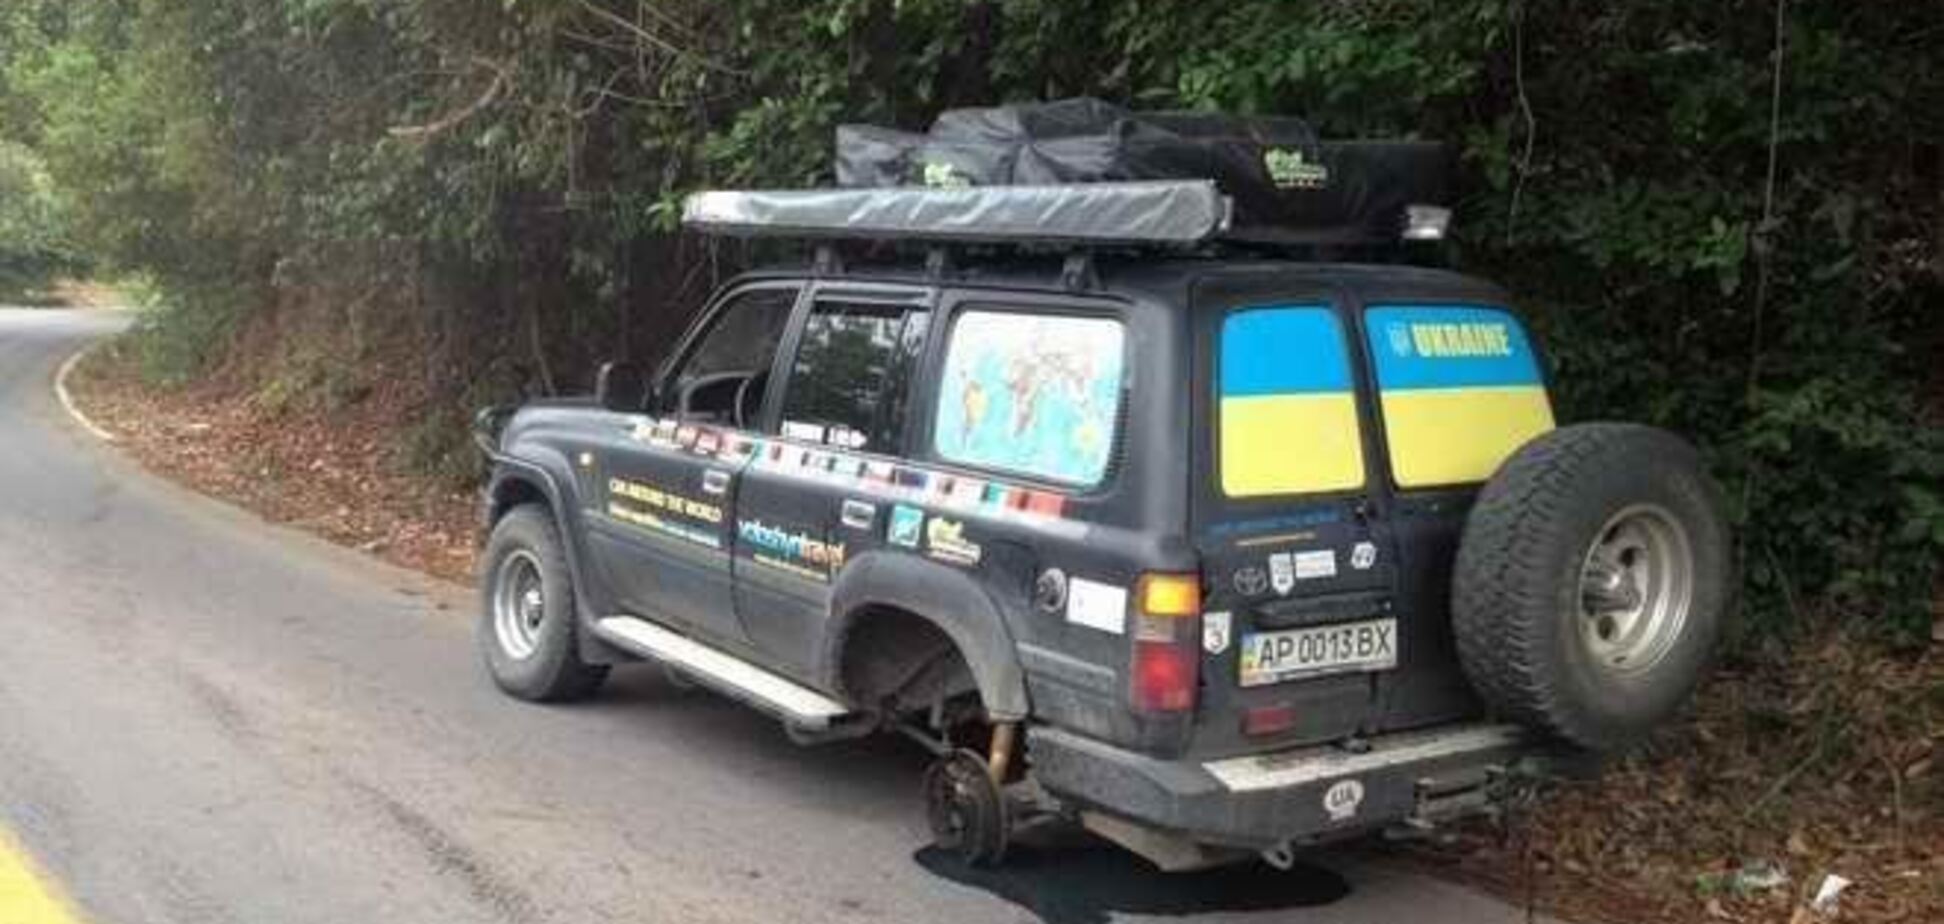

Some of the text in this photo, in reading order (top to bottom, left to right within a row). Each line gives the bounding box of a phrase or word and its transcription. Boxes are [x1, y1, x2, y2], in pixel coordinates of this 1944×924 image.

[1412, 323, 1512, 358] UKRAINE
[1260, 623, 1392, 664] AP 0013 BX
